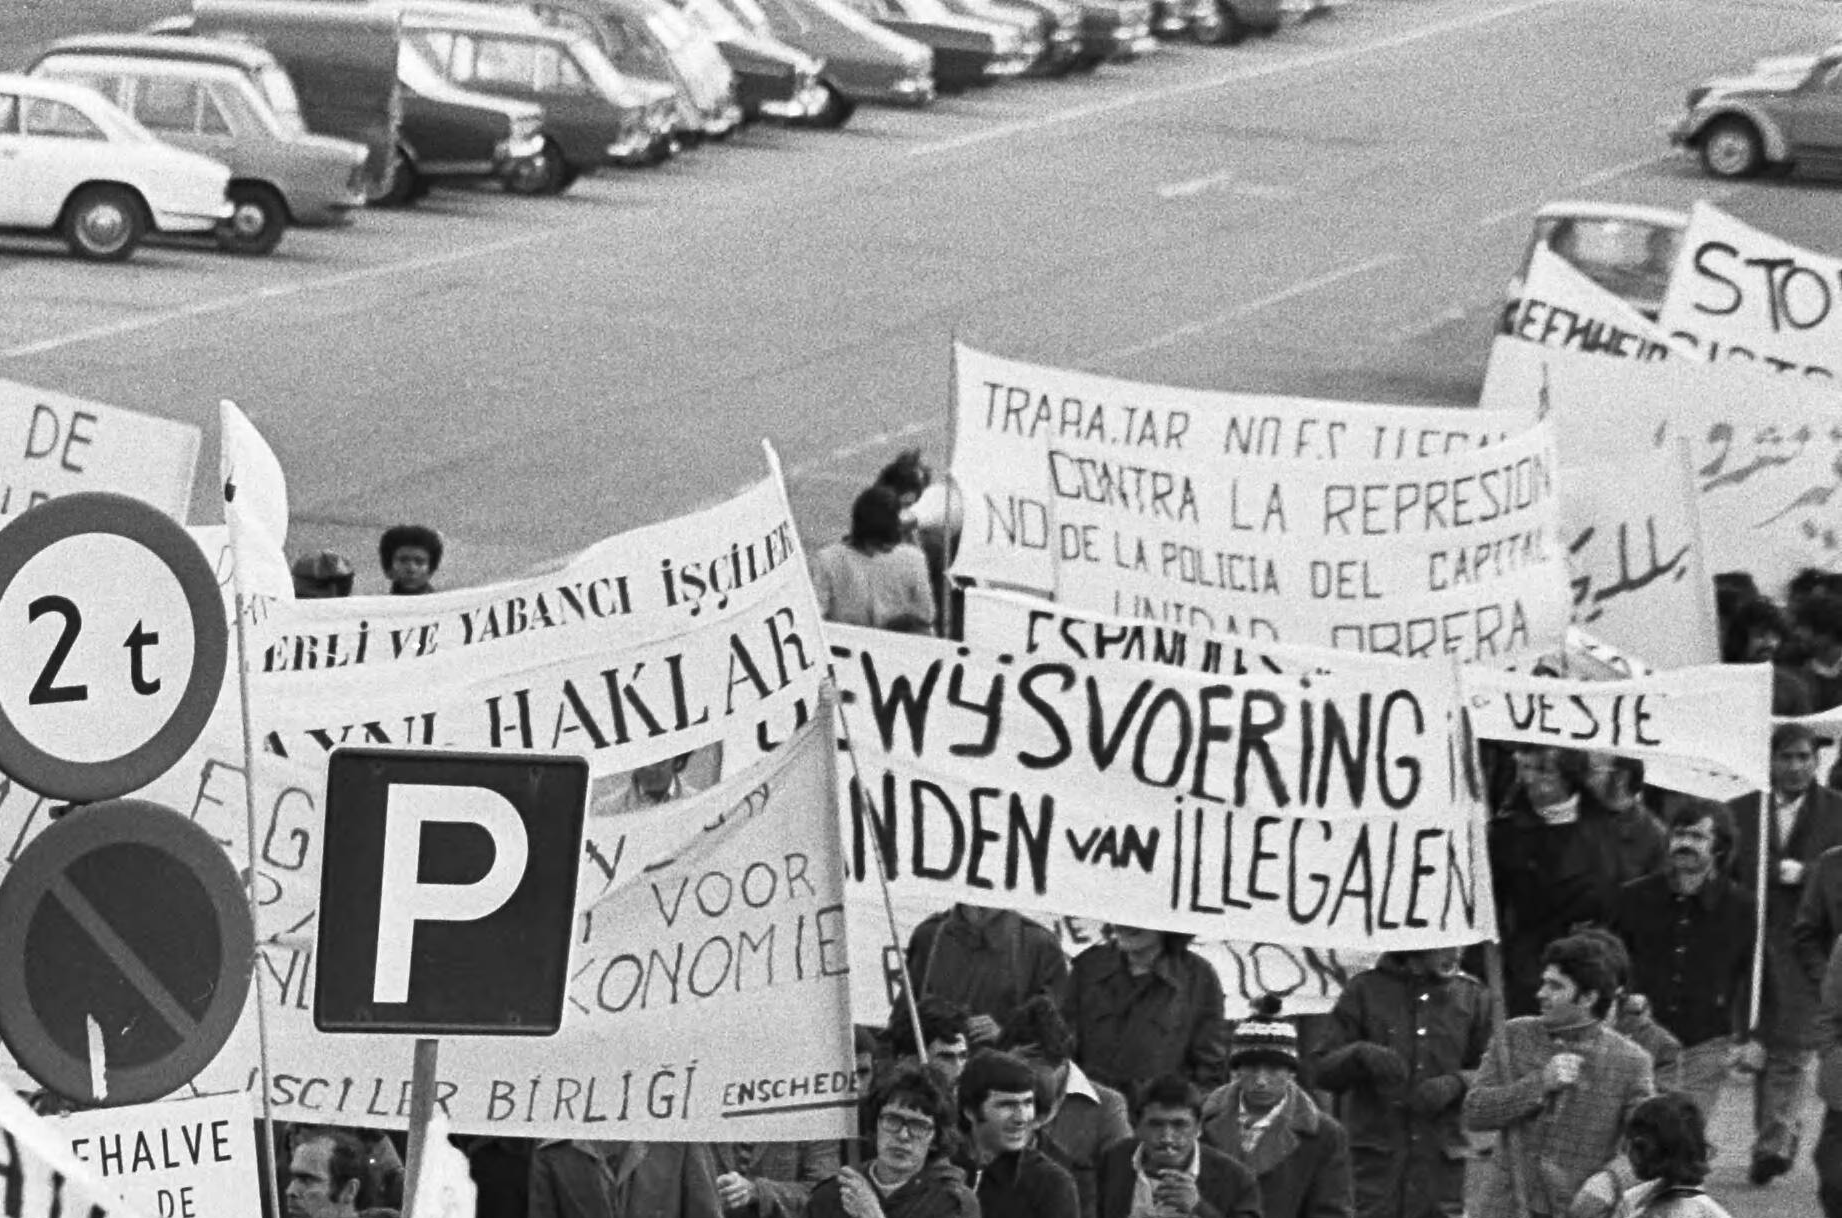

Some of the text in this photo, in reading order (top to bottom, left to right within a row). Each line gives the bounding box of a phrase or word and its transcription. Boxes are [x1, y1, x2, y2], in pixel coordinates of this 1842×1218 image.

[1693, 240, 1842, 334] STO
[24, 403, 98, 473] DE
[1231, 478, 1287, 533] LA
[1060, 523, 1100, 563] DE
[1114, 530, 1148, 570] LA
[1162, 541, 1281, 595] POLICIA
[1311, 560, 1383, 600] DEL
[389, 622, 440, 660] VE
[459, 574, 634, 646] YABANCI
[484, 606, 816, 755] HAKLAR
[842, 769, 1056, 896] NDEN
[1066, 822, 1159, 873] VAN
[372, 782, 529, 1004] P
[651, 852, 816, 928] VOOR
[722, 1070, 859, 1107] ENSCHEDE
